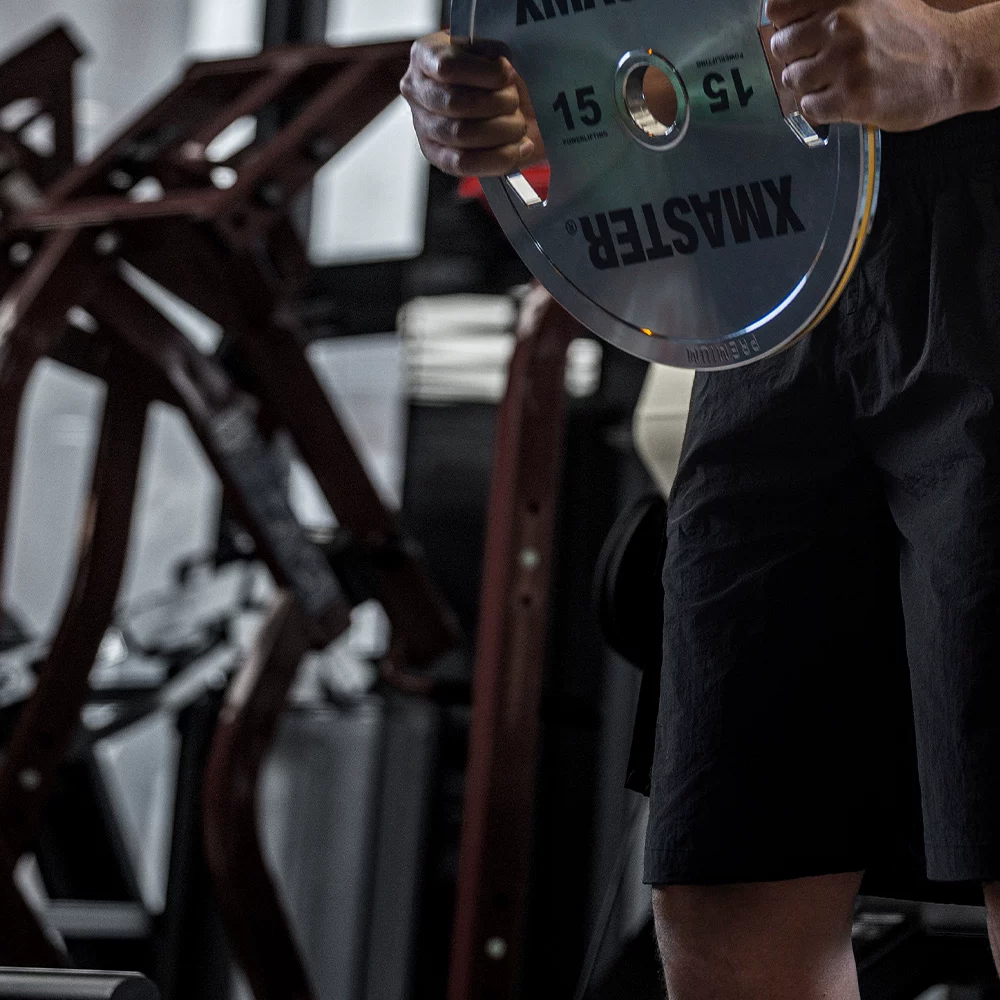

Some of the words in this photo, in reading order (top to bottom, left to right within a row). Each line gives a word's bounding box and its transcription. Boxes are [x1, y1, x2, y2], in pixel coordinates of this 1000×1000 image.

[552, 85, 602, 131] 15
[702, 67, 754, 114] 15
[686, 333, 760, 364] PREMIUM
